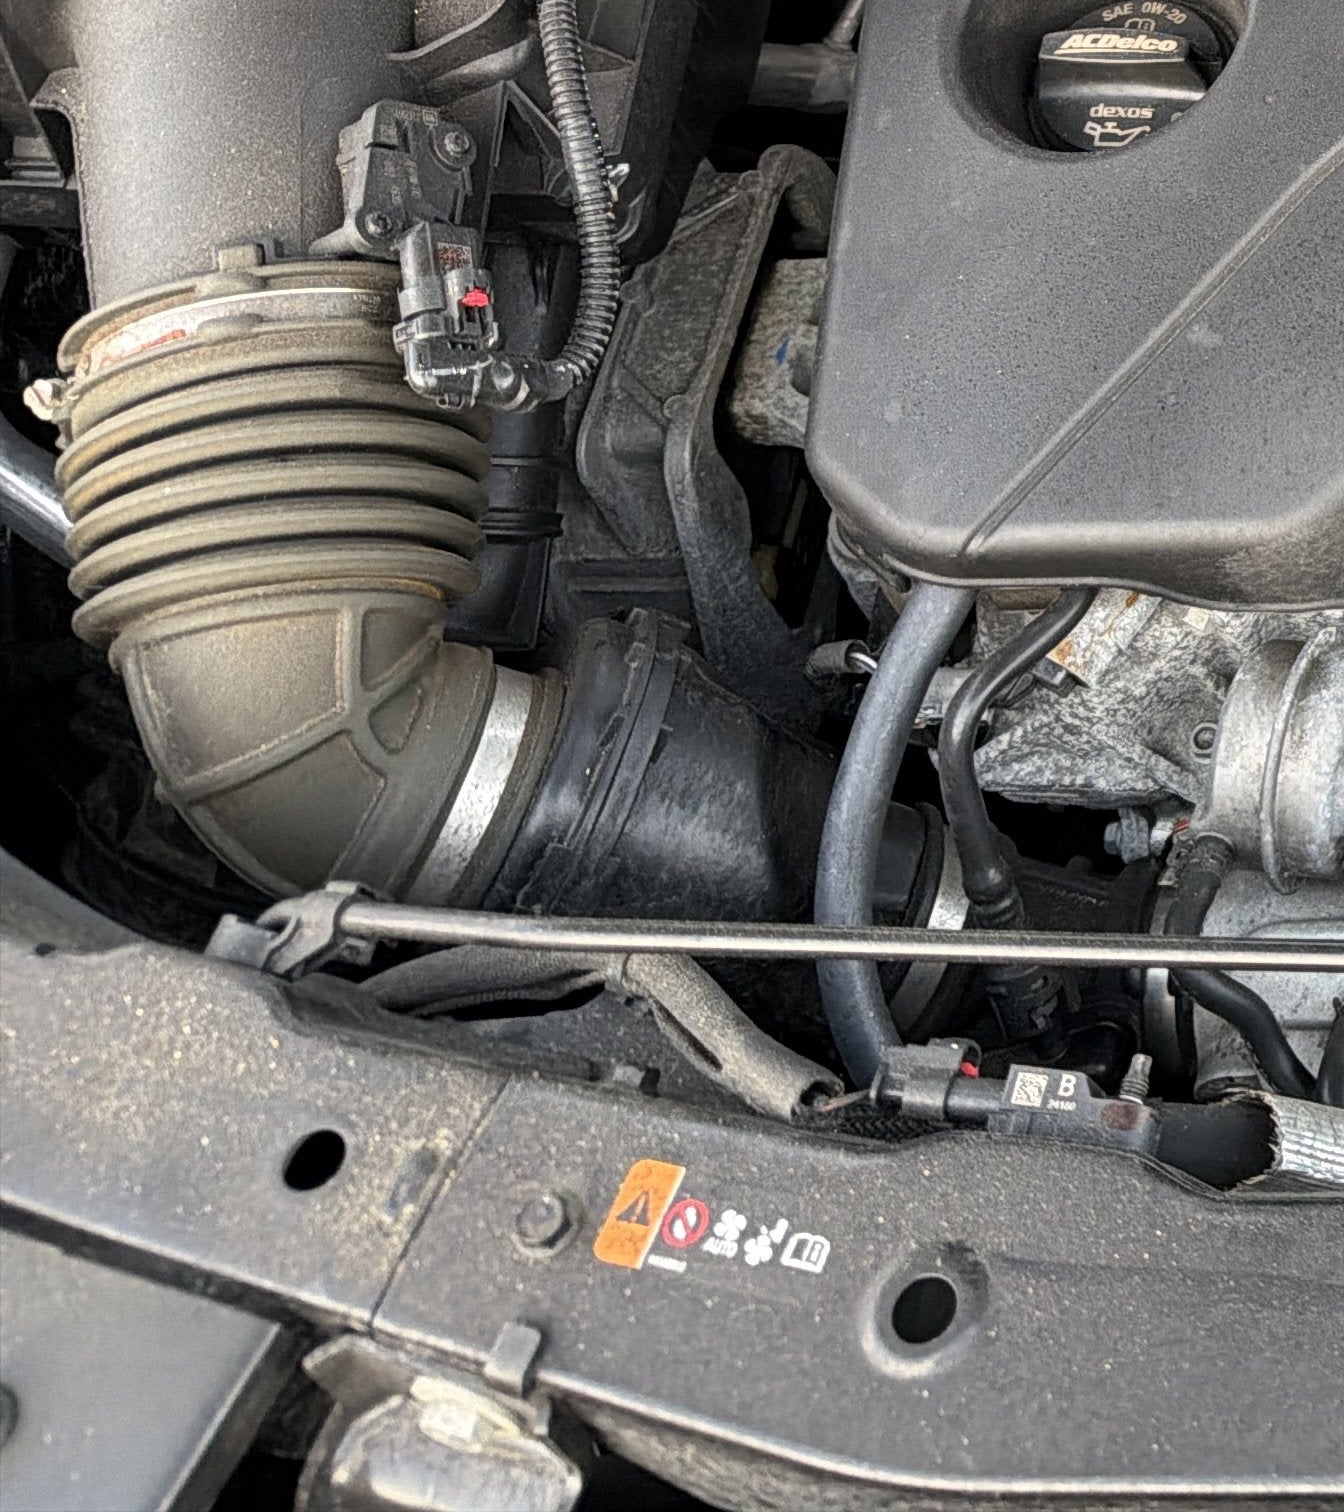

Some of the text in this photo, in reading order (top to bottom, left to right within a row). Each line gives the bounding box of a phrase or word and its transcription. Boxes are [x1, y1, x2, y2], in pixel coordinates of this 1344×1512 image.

[1102, 1, 1188, 25] SAE 0W-20
[1059, 34, 1179, 52] ACDelco
[1089, 103, 1156, 119] dexos
[1057, 1073, 1077, 1097] B
[702, 1236, 738, 1259] AUTO
